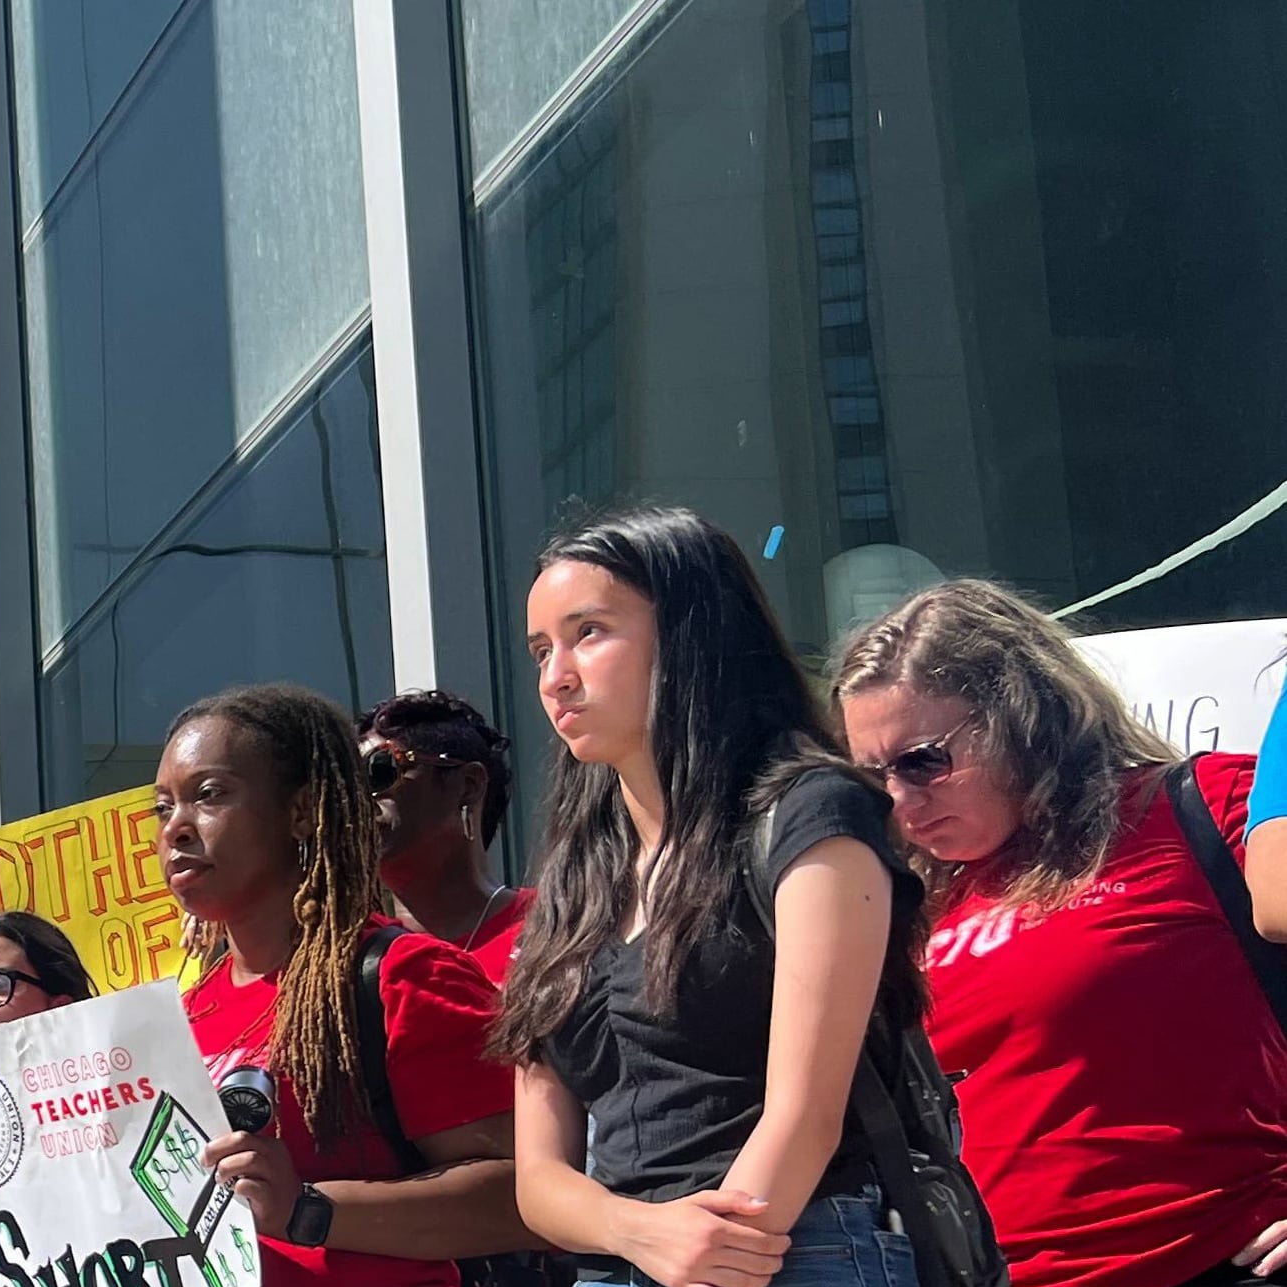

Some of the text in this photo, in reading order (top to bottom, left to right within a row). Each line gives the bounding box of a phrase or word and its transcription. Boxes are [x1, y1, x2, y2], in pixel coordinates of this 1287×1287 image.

[23, 1046, 133, 1092] CHICAGO
[1, 1092, 20, 1143] UNION
[31, 1076, 156, 1126] TEACHERS
[40, 1121, 120, 1159] UNION
